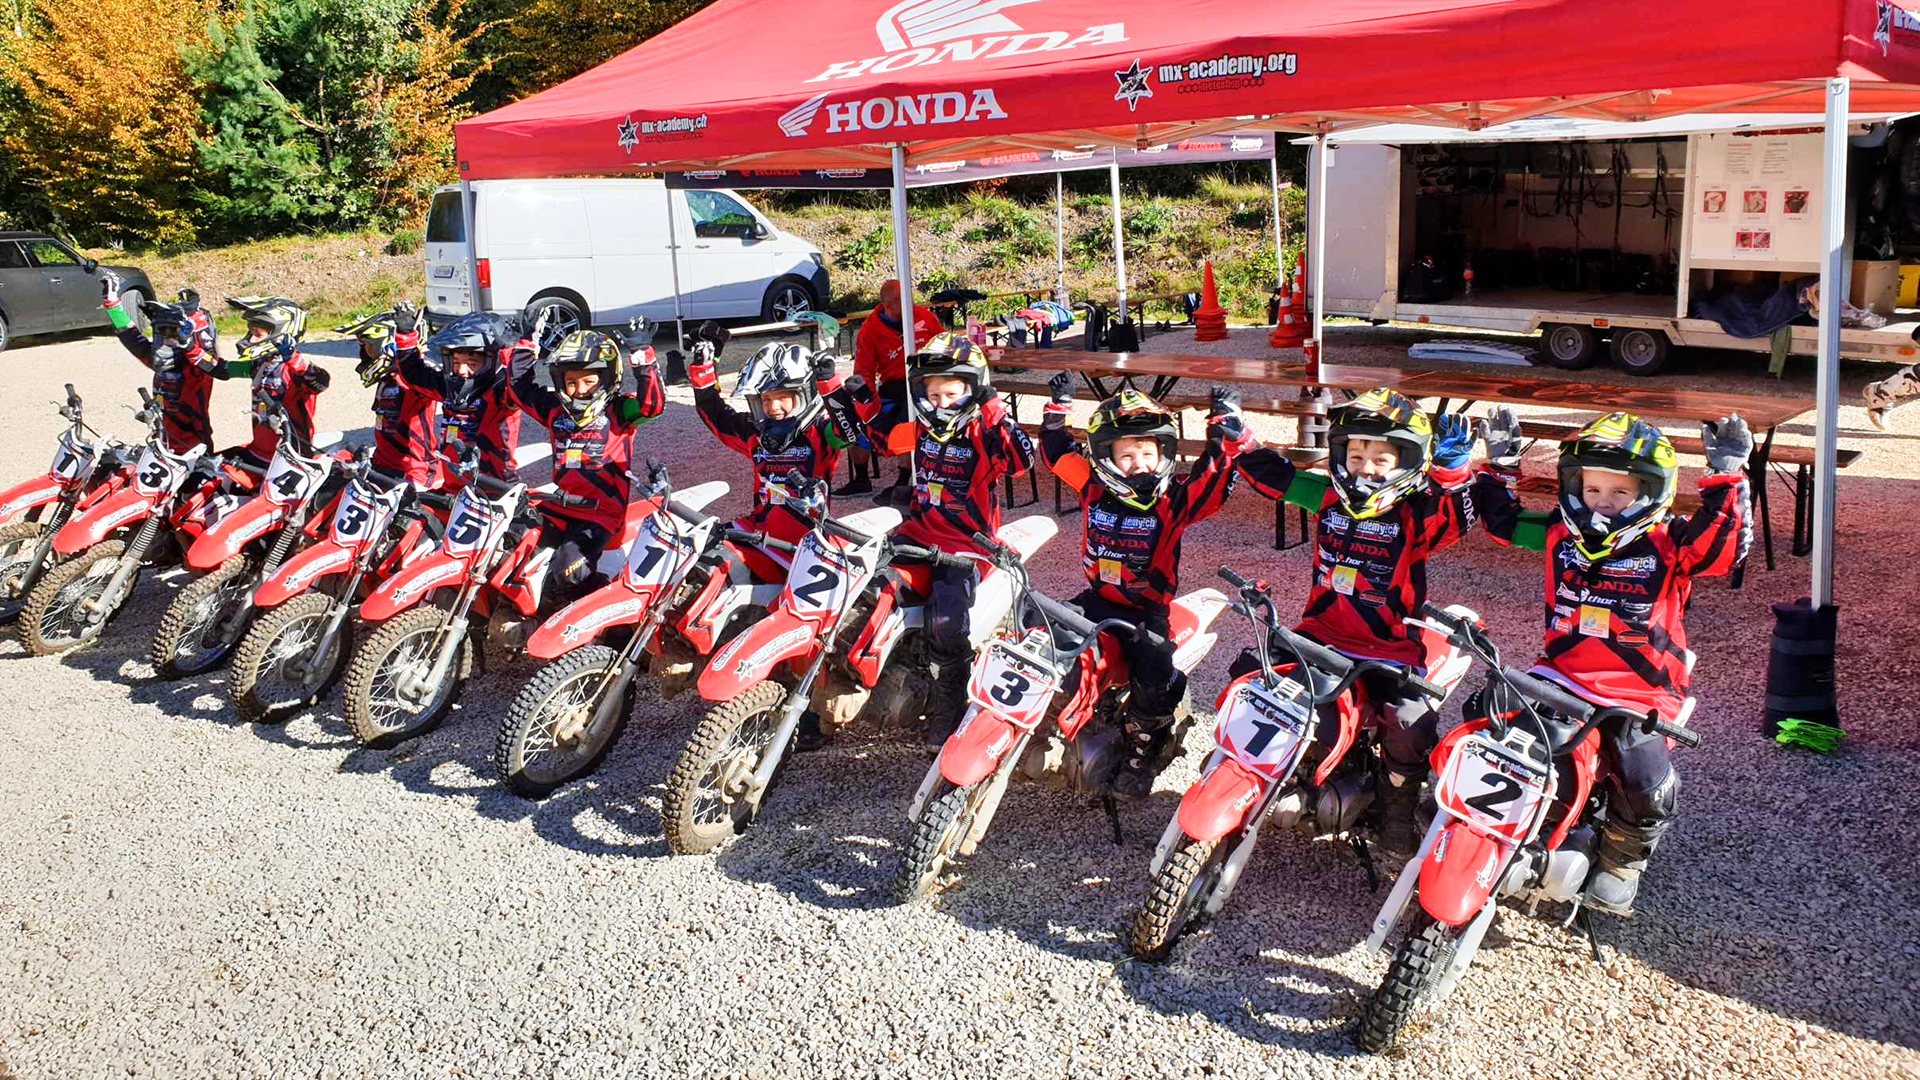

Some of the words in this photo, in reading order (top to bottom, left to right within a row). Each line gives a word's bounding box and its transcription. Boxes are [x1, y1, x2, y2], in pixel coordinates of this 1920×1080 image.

[802, 22, 1131, 83] HONDA
[1159, 53, 1297, 83] mx-academy.org
[826, 88, 1007, 133] HONDA
[57, 452, 77, 473] 1
[140, 462, 169, 487] 3
[272, 470, 304, 496] 4
[337, 504, 369, 535] 3
[449, 512, 488, 545] 5
[635, 545, 666, 578] 1
[794, 565, 839, 608] 2
[1170, 627, 1194, 644] NDA
[990, 671, 1030, 706] 3
[1244, 720, 1281, 757] 1
[1464, 773, 1523, 821] 2
